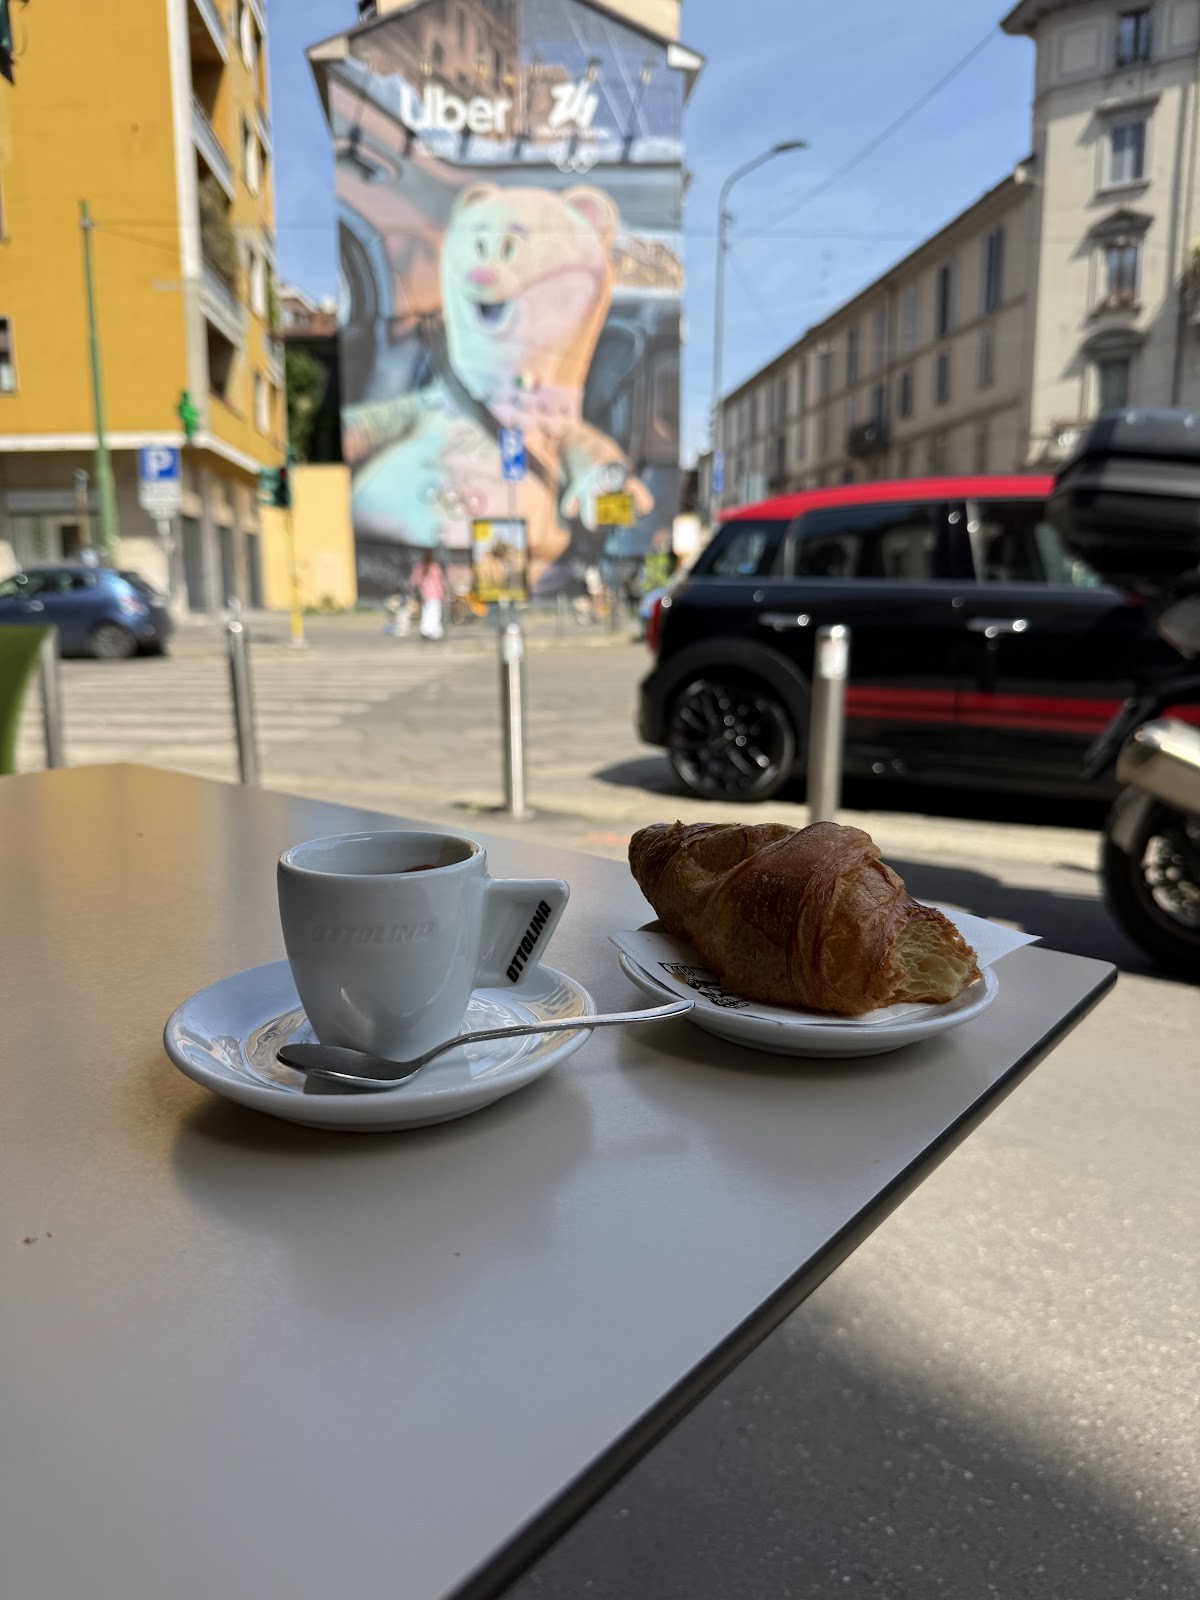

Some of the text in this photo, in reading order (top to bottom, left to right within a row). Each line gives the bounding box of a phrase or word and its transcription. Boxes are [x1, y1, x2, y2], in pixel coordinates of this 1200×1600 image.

[400, 84, 513, 133] Uber
[144, 447, 173, 480] P
[505, 900, 552, 983] OTTOLINA
